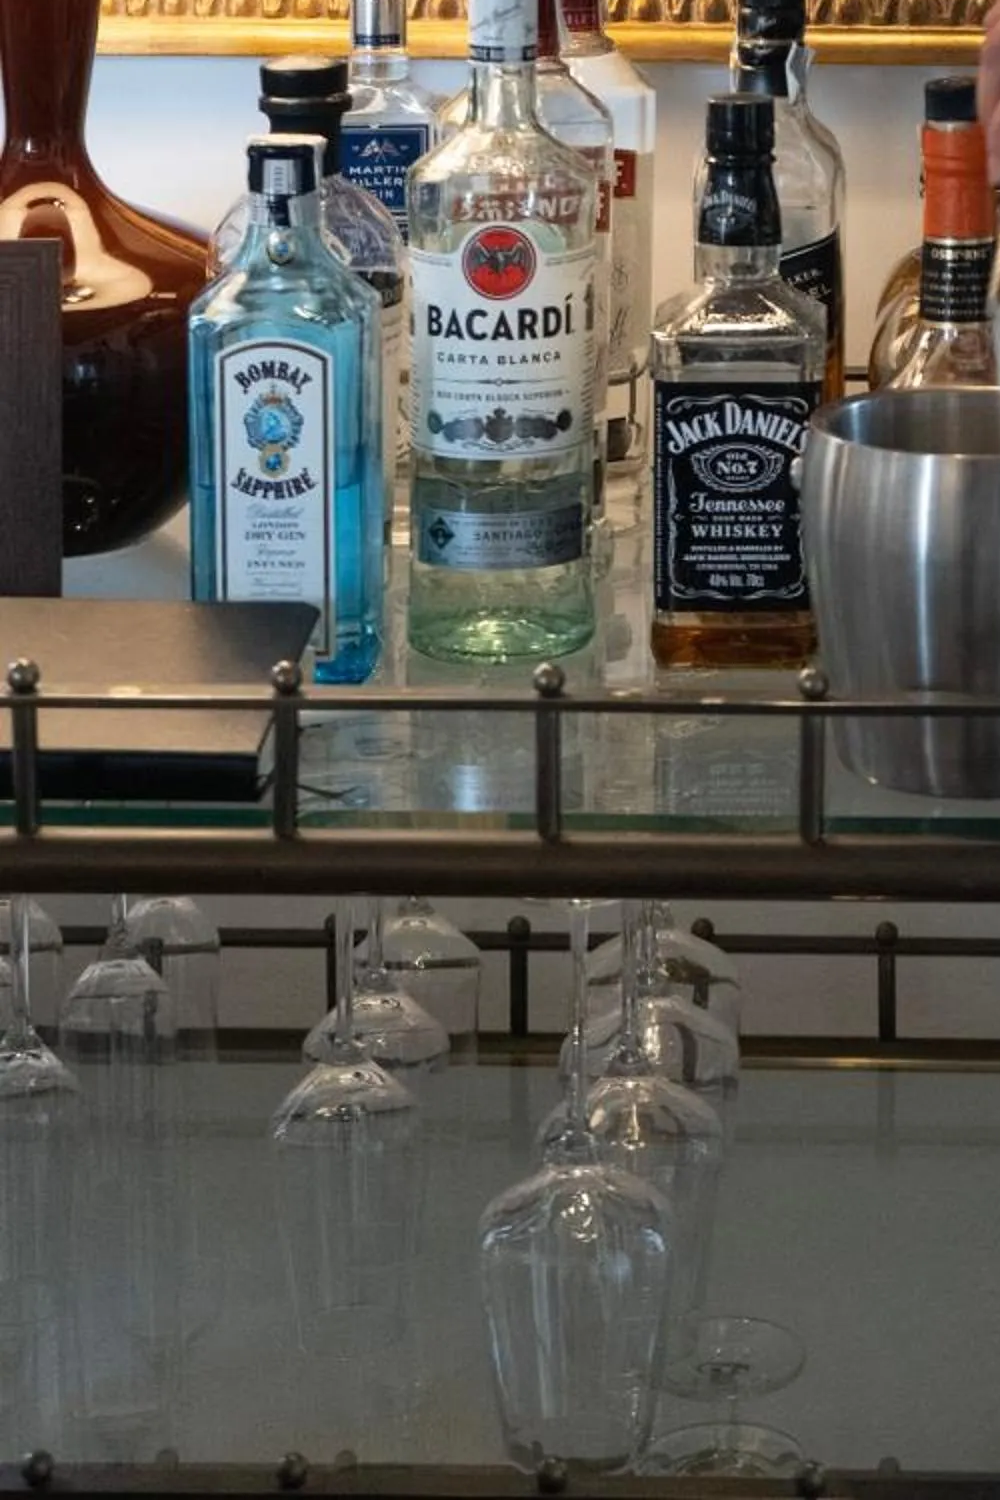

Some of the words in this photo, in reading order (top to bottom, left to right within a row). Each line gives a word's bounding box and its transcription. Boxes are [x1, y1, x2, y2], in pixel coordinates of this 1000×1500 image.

[426, 292, 574, 342] BACARDÍ
[436, 351, 489, 365] CARTA
[497, 350, 562, 366] BLANCA
[233, 360, 313, 395] BOMBAY
[665, 410, 724, 455] JACK
[230, 466, 319, 501] SAPPHIRE
[688, 491, 785, 513] Tennessee
[691, 523, 784, 538] WHISKEY
